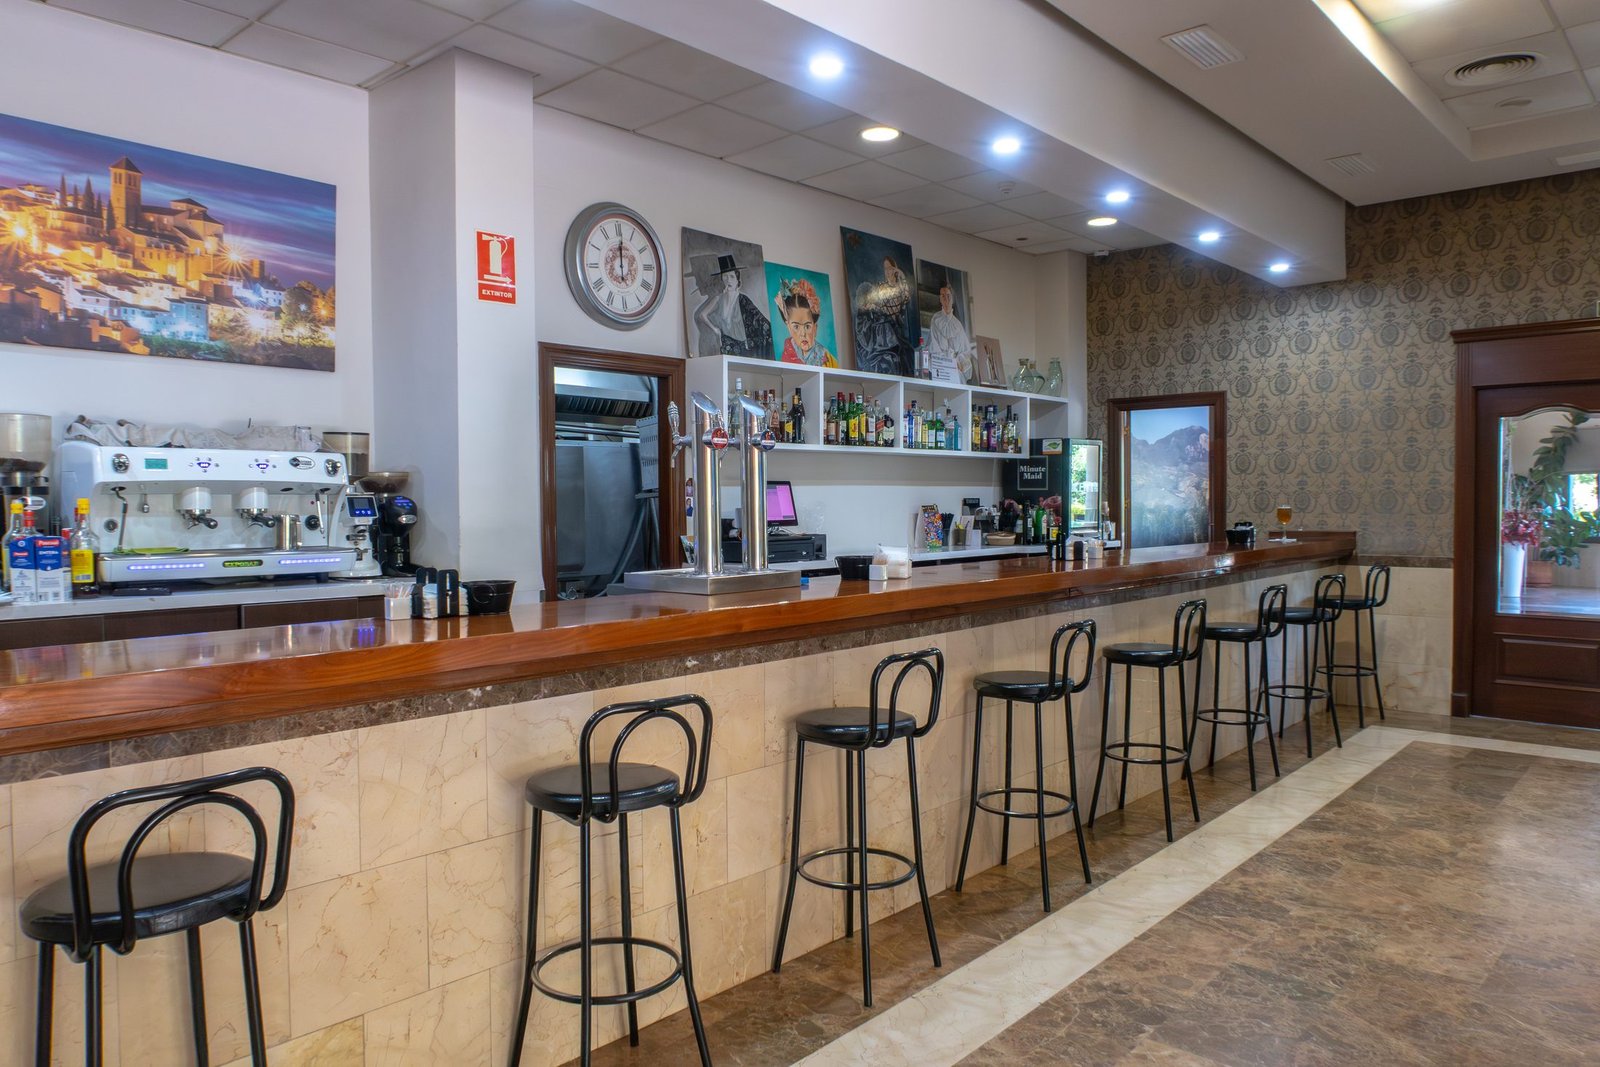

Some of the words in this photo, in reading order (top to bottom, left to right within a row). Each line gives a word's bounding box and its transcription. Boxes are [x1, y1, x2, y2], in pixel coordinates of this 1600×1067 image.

[481, 289, 513, 299] EXTINTOR
[1019, 465, 1046, 473] Minute
[1023, 472, 1042, 480] Maid
